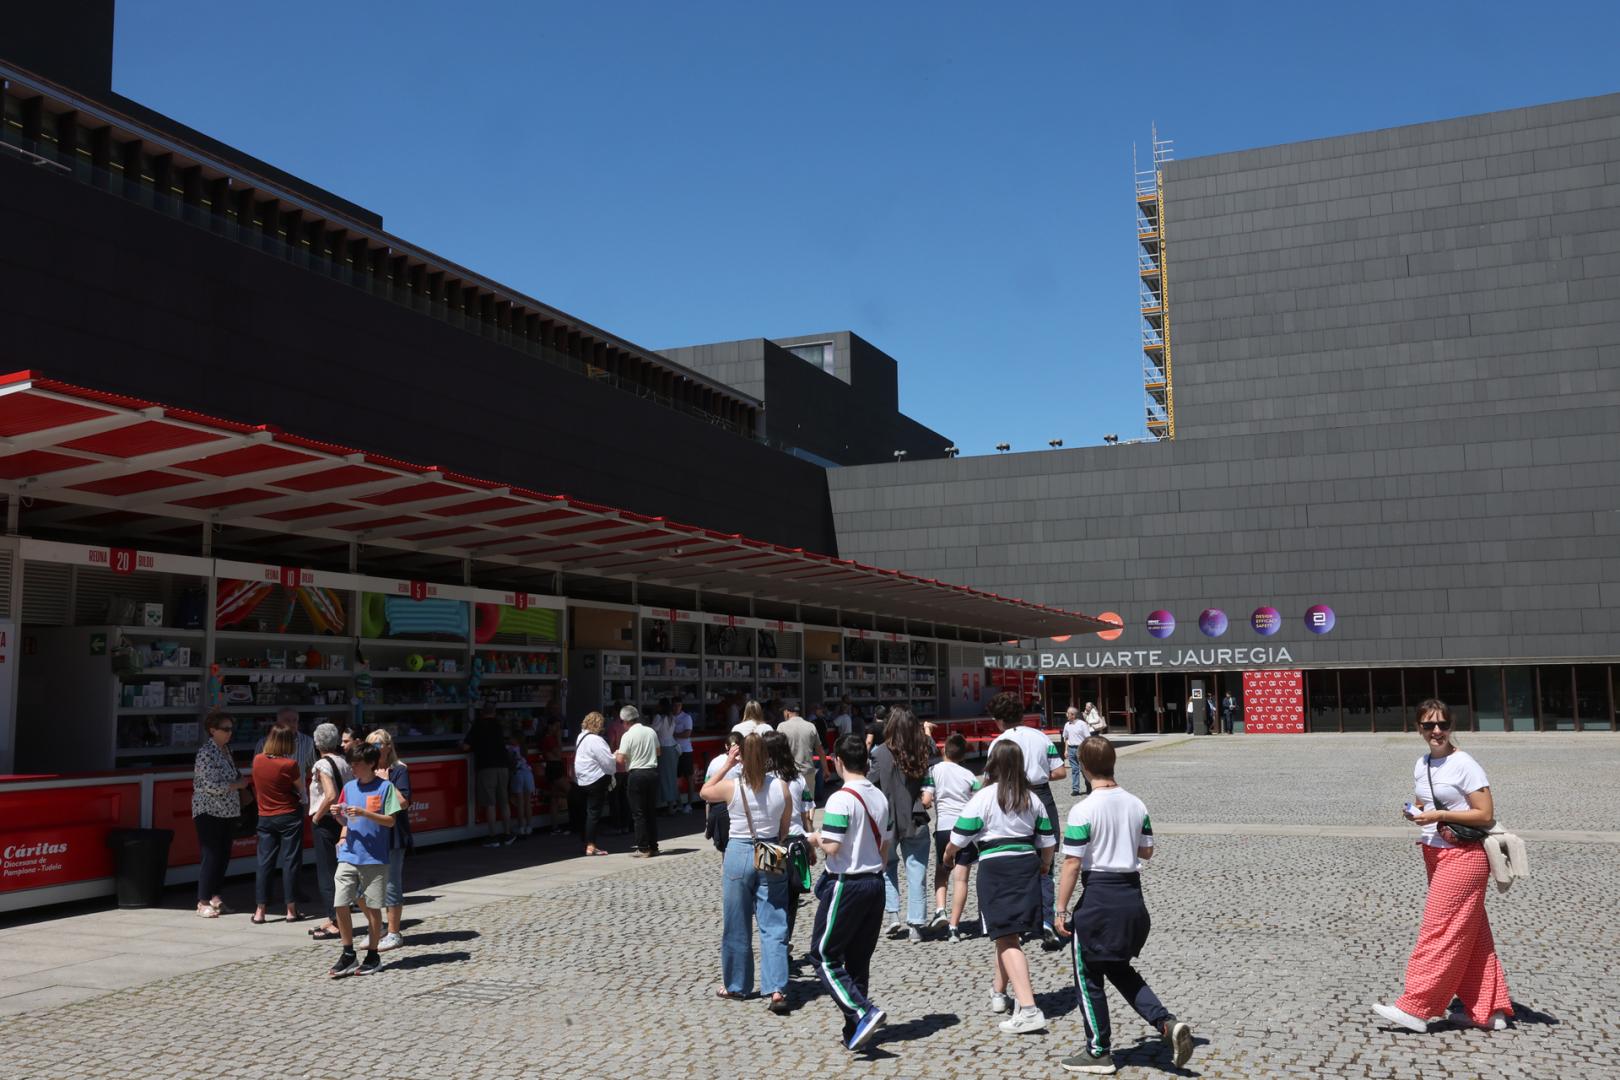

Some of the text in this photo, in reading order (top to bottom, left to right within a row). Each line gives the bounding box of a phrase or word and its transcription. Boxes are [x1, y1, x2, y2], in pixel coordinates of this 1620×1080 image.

[118, 552, 129, 570] 20
[1040, 650, 1162, 668] BALUARTE
[1169, 646, 1293, 665] JAUREGIA
[4, 842, 68, 859] Cáritas
[3, 856, 47, 869] Diocesana de
